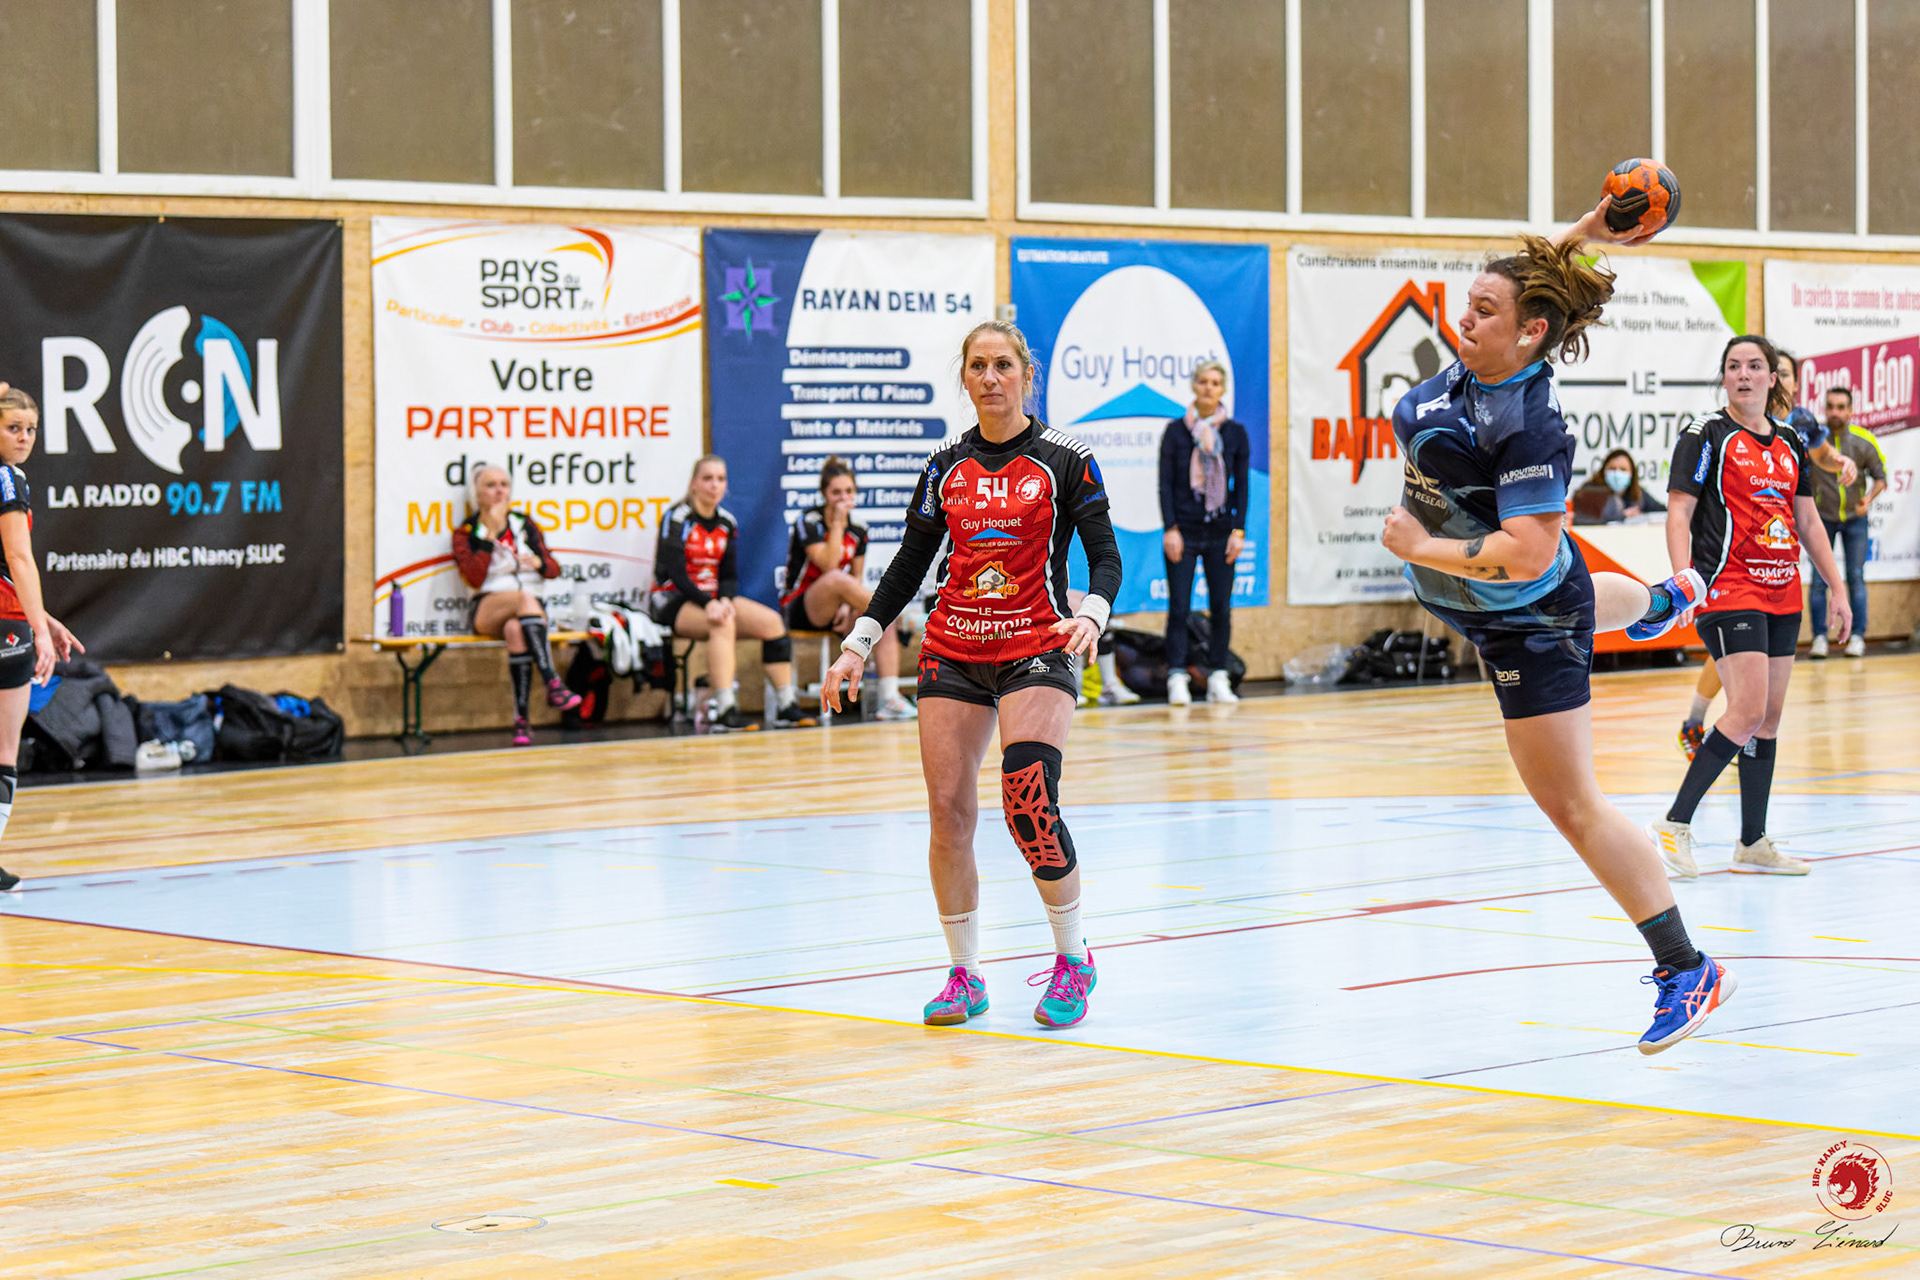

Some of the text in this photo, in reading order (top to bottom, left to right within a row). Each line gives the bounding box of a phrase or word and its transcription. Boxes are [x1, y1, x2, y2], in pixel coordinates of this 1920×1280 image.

[481, 259, 558, 283] PAYS
[1297, 253, 1376, 268] Construisons
[1380, 256, 1437, 270] ensemble
[1443, 260, 1472, 272] votre
[803, 289, 972, 313] RAYAN DEM 54
[480, 319, 514, 335] Club
[789, 348, 902, 368] Déménagement
[1061, 345, 1113, 387] Guy
[491, 359, 593, 391] Votre
[1632, 372, 1657, 394] LE
[1862, 344, 1914, 412] Léon
[790, 384, 926, 403] Transport de Piano
[406, 405, 670, 438] PARTENAIRE
[790, 418, 924, 437] Vente de Matériels
[507, 451, 636, 484] l'effort
[855, 453, 874, 471] de
[1508, 464, 1548, 479] BOUTIQUE
[1750, 475, 1766, 488] Guy
[48, 480, 282, 515] LA RADIO 90.7 FM
[975, 477, 1009, 509] 54
[1414, 491, 1448, 510] RESEAU
[407, 497, 670, 535] MUISPORT
[960, 516, 1022, 532] Guy Hoquet
[46, 543, 285, 572] Partenaire du HBC Nancy SLUC
[979, 607, 992, 616] LE
[947, 614, 1033, 634] COMPTOIR
